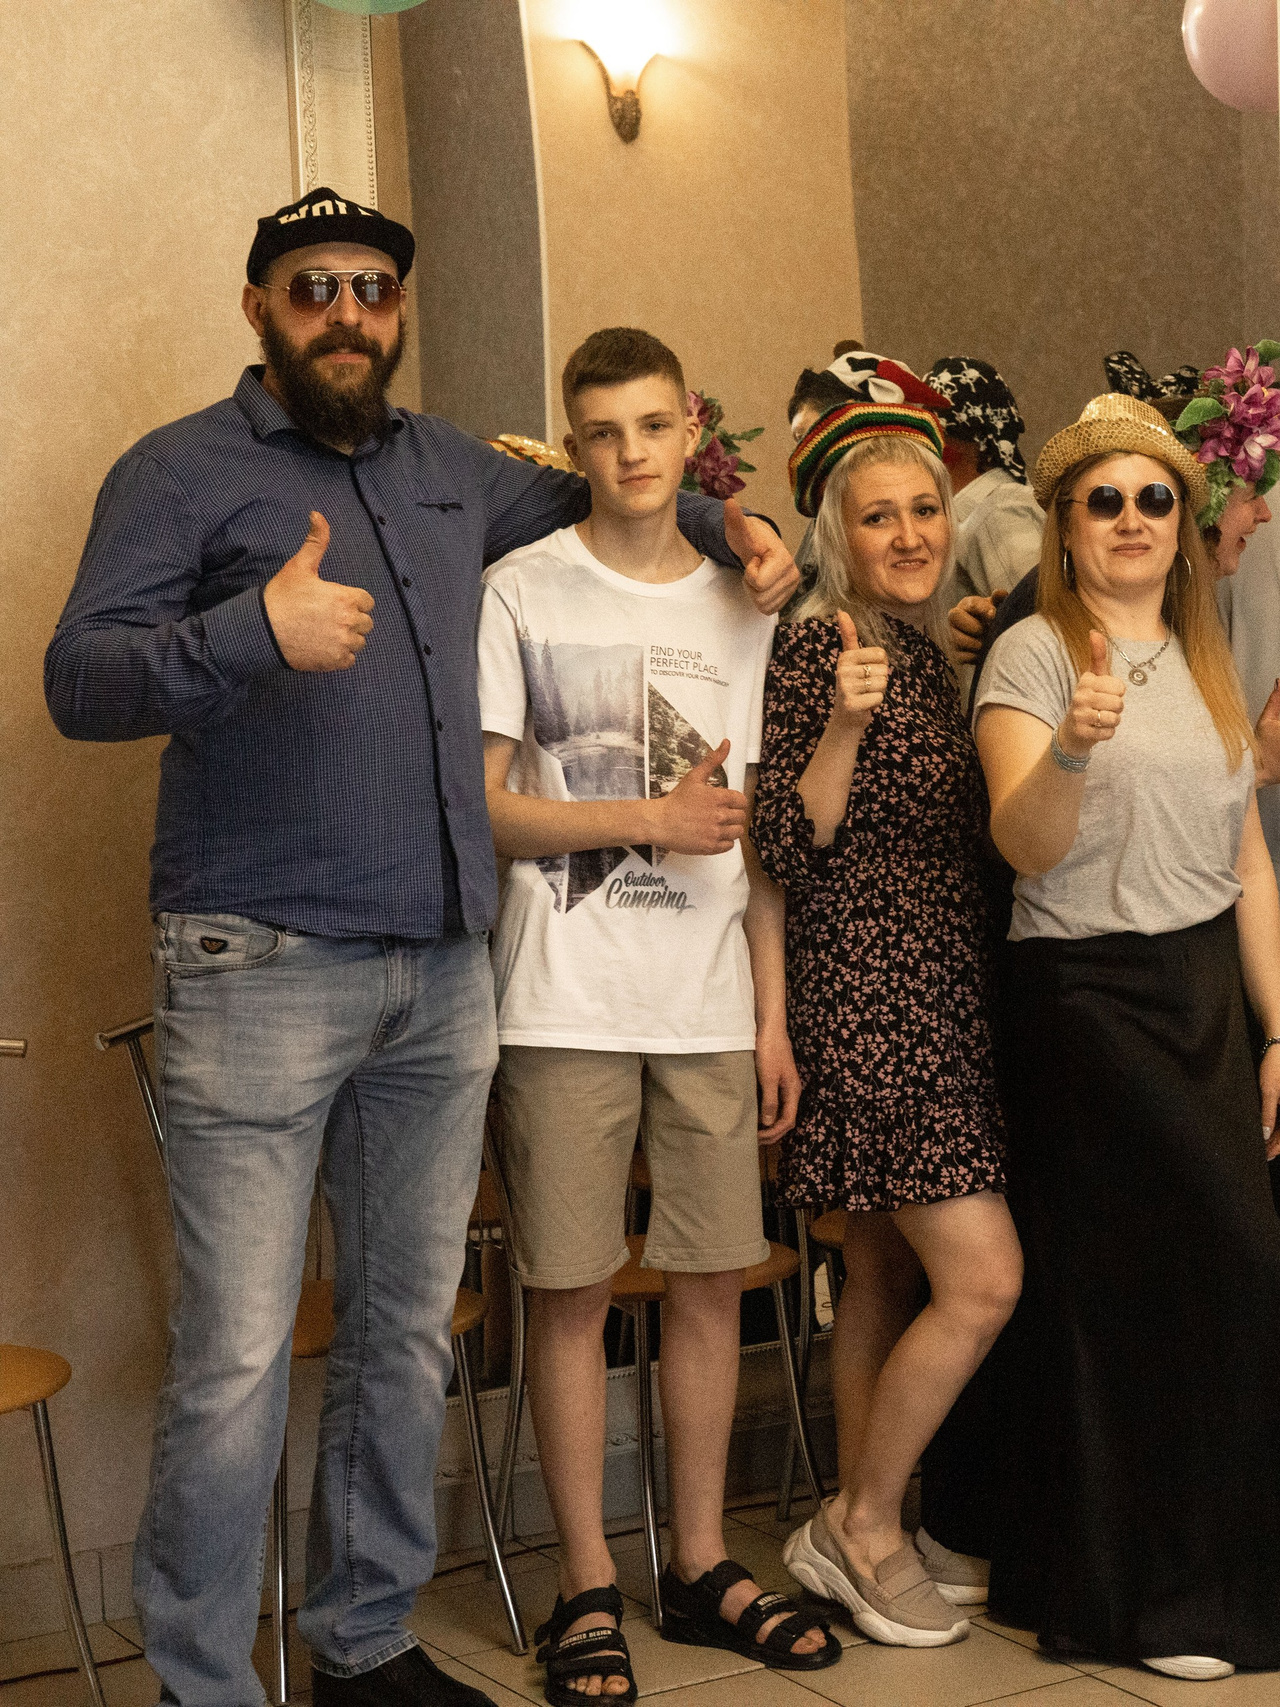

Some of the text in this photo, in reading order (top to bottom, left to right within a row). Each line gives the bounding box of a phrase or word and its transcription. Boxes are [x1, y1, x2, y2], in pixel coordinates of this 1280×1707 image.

[650, 645, 703, 661] FIND YOUR
[650, 657, 718, 676] PERFECT PLACE
[624, 870, 667, 888] Outdoor
[605, 878, 697, 915] Camping
